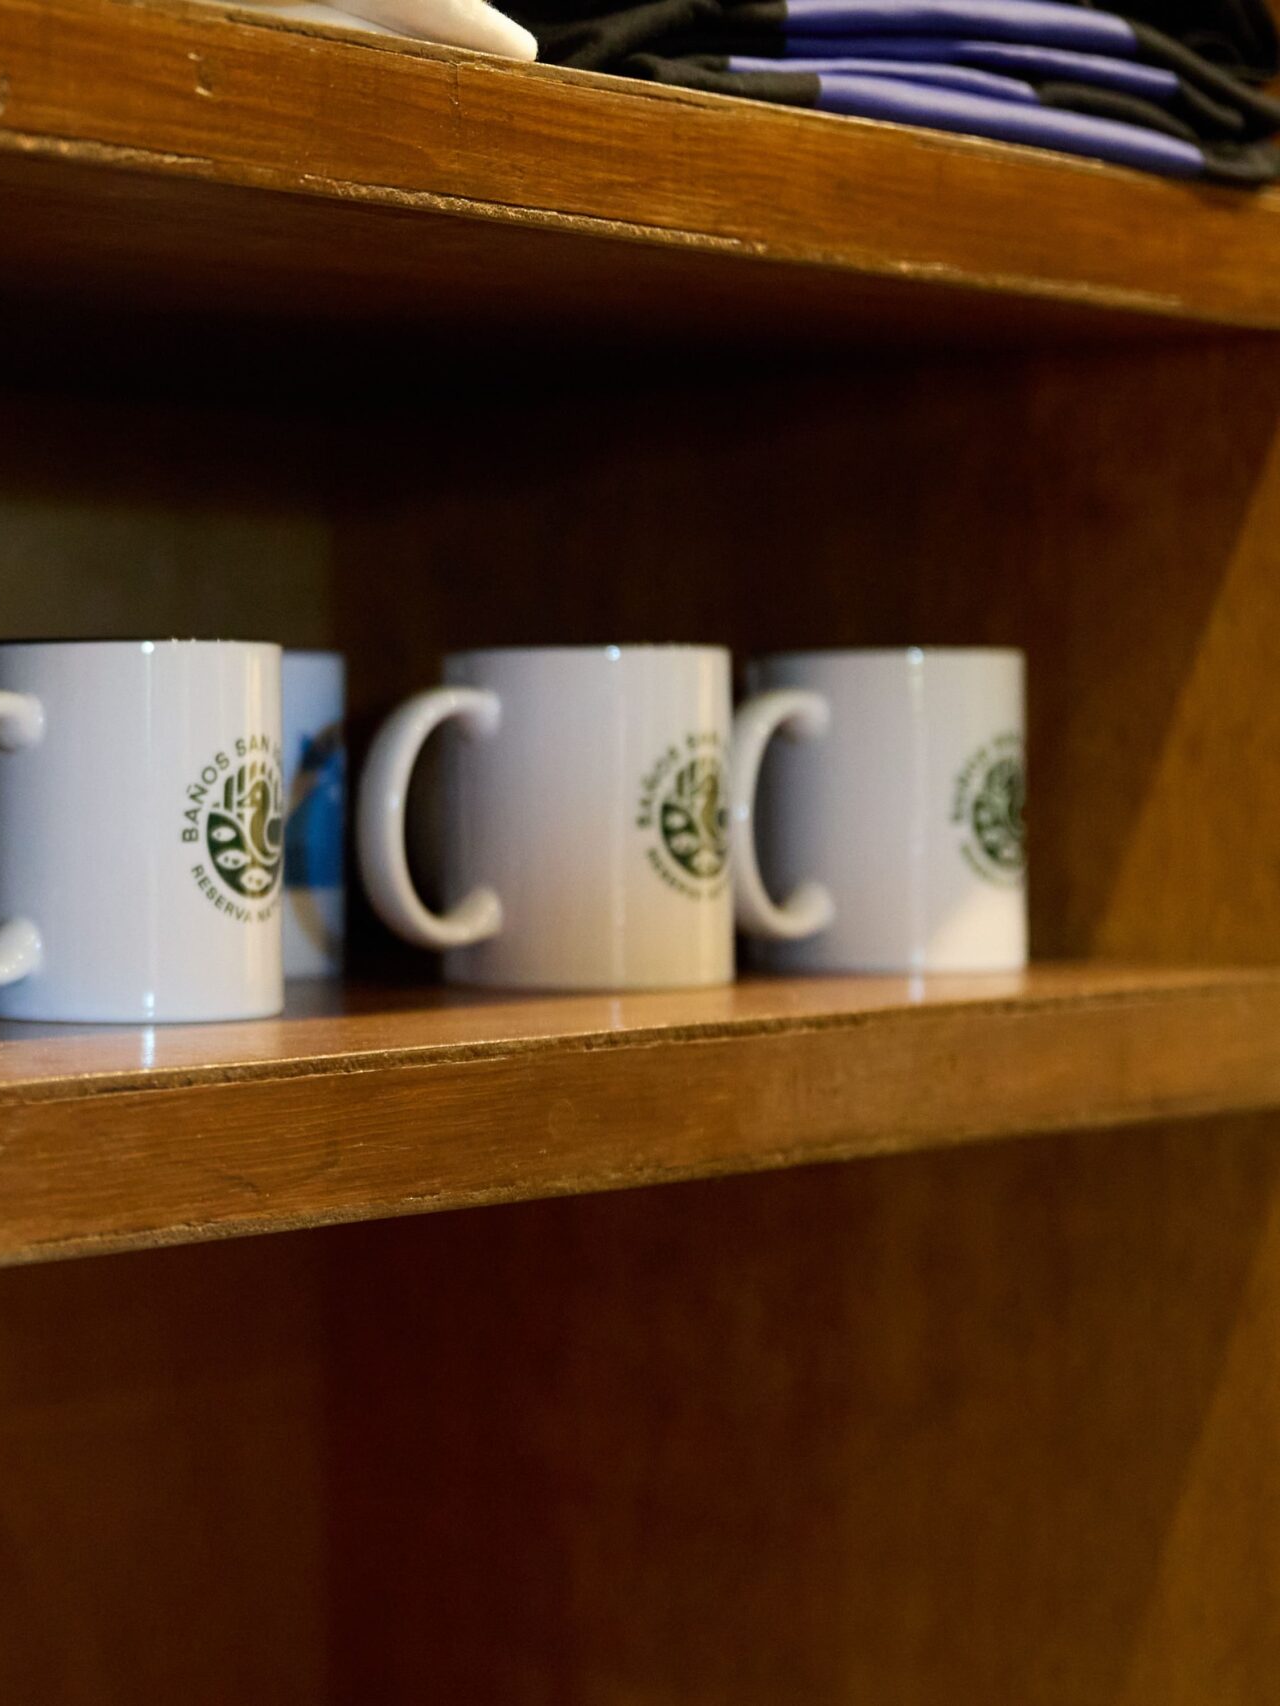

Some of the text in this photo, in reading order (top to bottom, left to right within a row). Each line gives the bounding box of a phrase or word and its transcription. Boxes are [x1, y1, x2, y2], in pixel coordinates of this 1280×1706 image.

[182, 734, 269, 843] BAÑOS SAN
[191, 864, 252, 923] RESERVA
